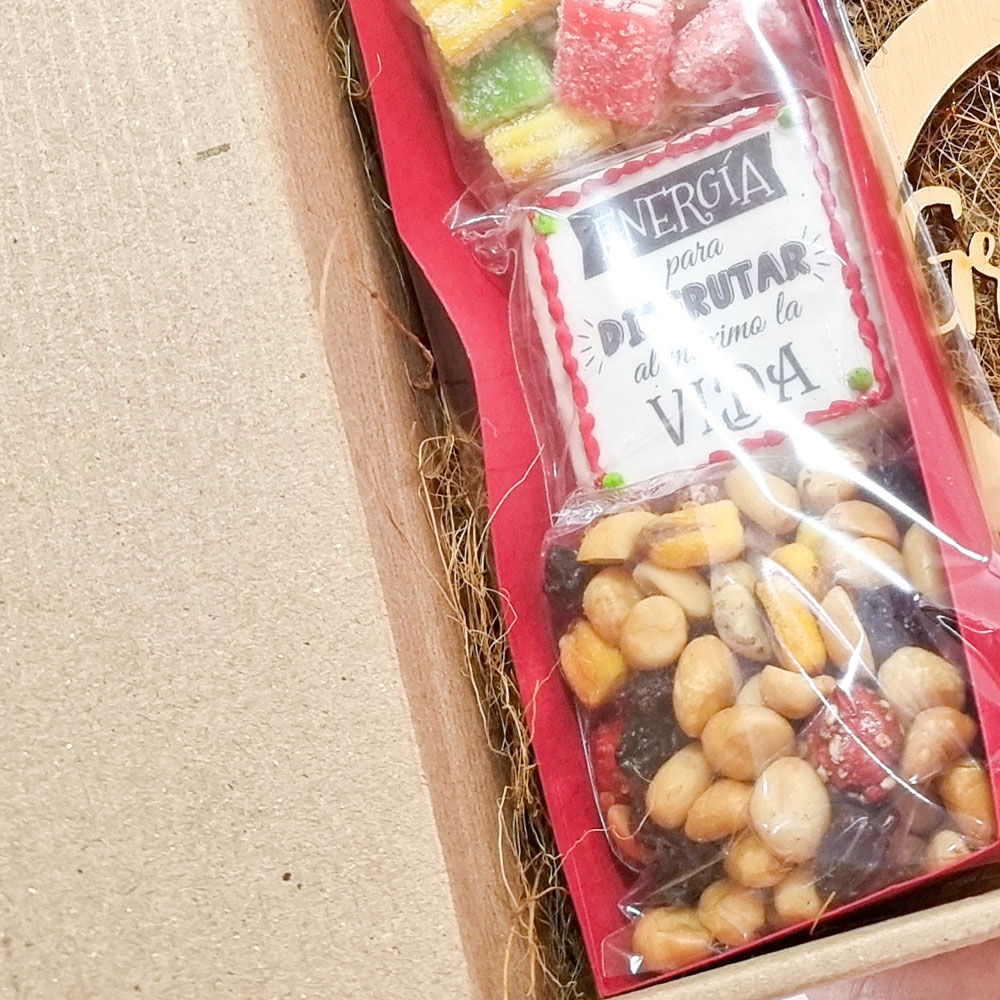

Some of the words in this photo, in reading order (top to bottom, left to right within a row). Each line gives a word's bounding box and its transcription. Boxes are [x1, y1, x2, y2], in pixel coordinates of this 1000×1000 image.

[597, 241, 811, 357] DIRUTAR
[665, 238, 725, 289] para
[633, 348, 661, 384] al
[774, 291, 803, 326] la
